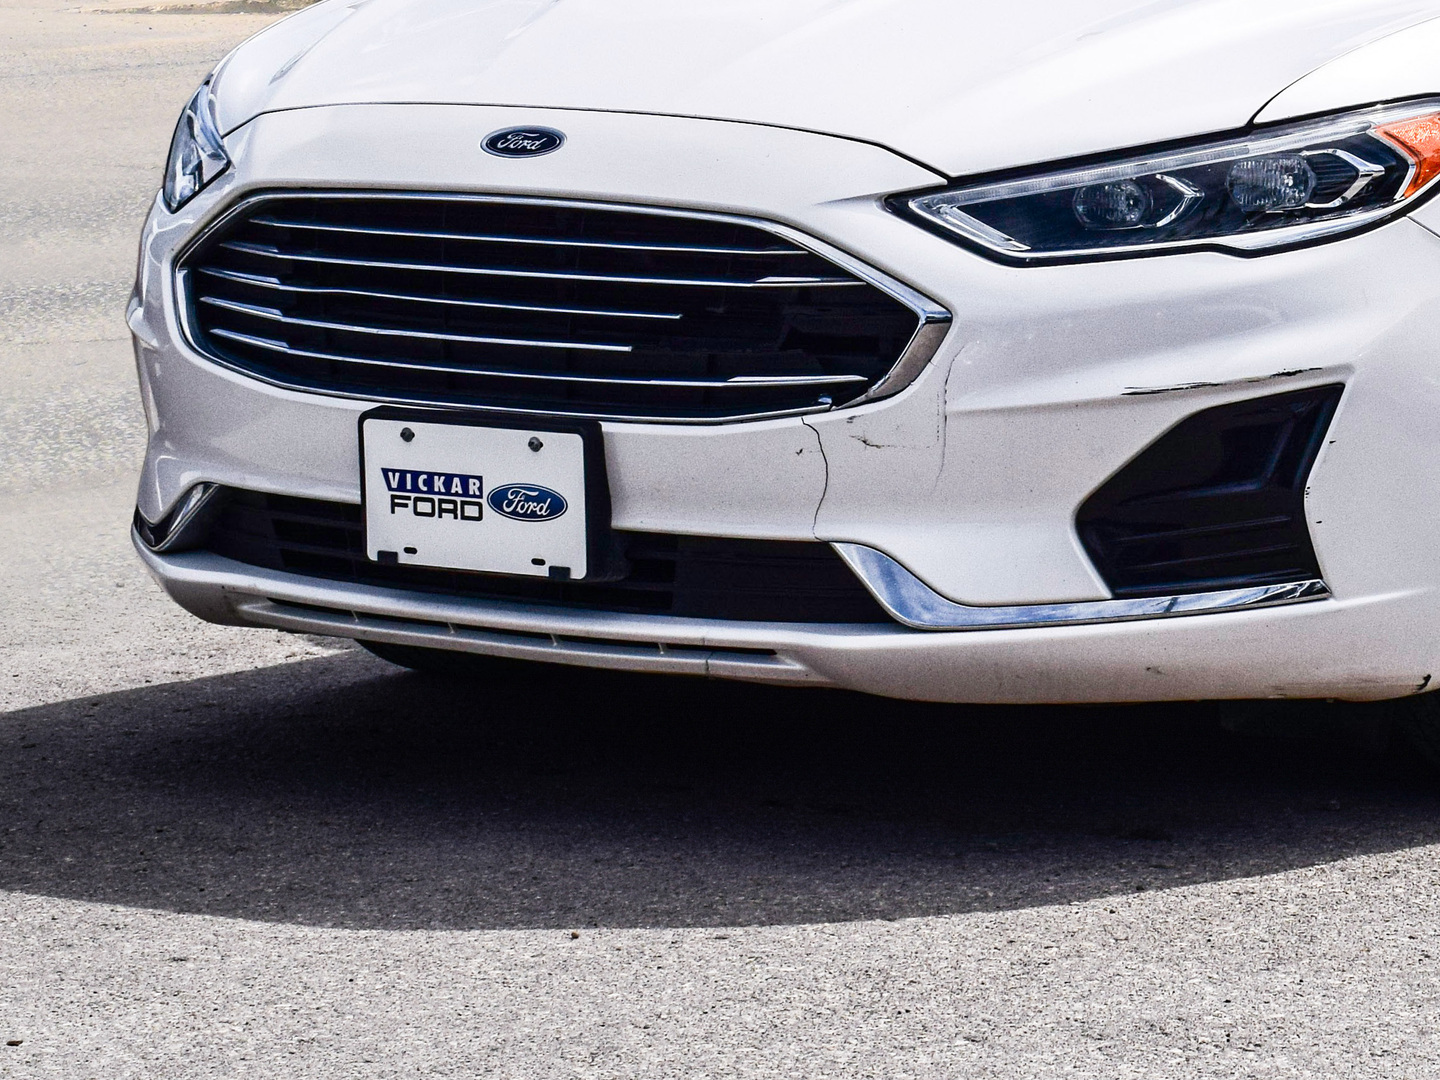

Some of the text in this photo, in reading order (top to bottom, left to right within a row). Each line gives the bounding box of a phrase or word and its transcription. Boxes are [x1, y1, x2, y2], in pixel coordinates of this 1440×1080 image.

[497, 132, 547, 150] Ford
[387, 471, 481, 497] VICKAR
[390, 487, 552, 521] FORD Ford
